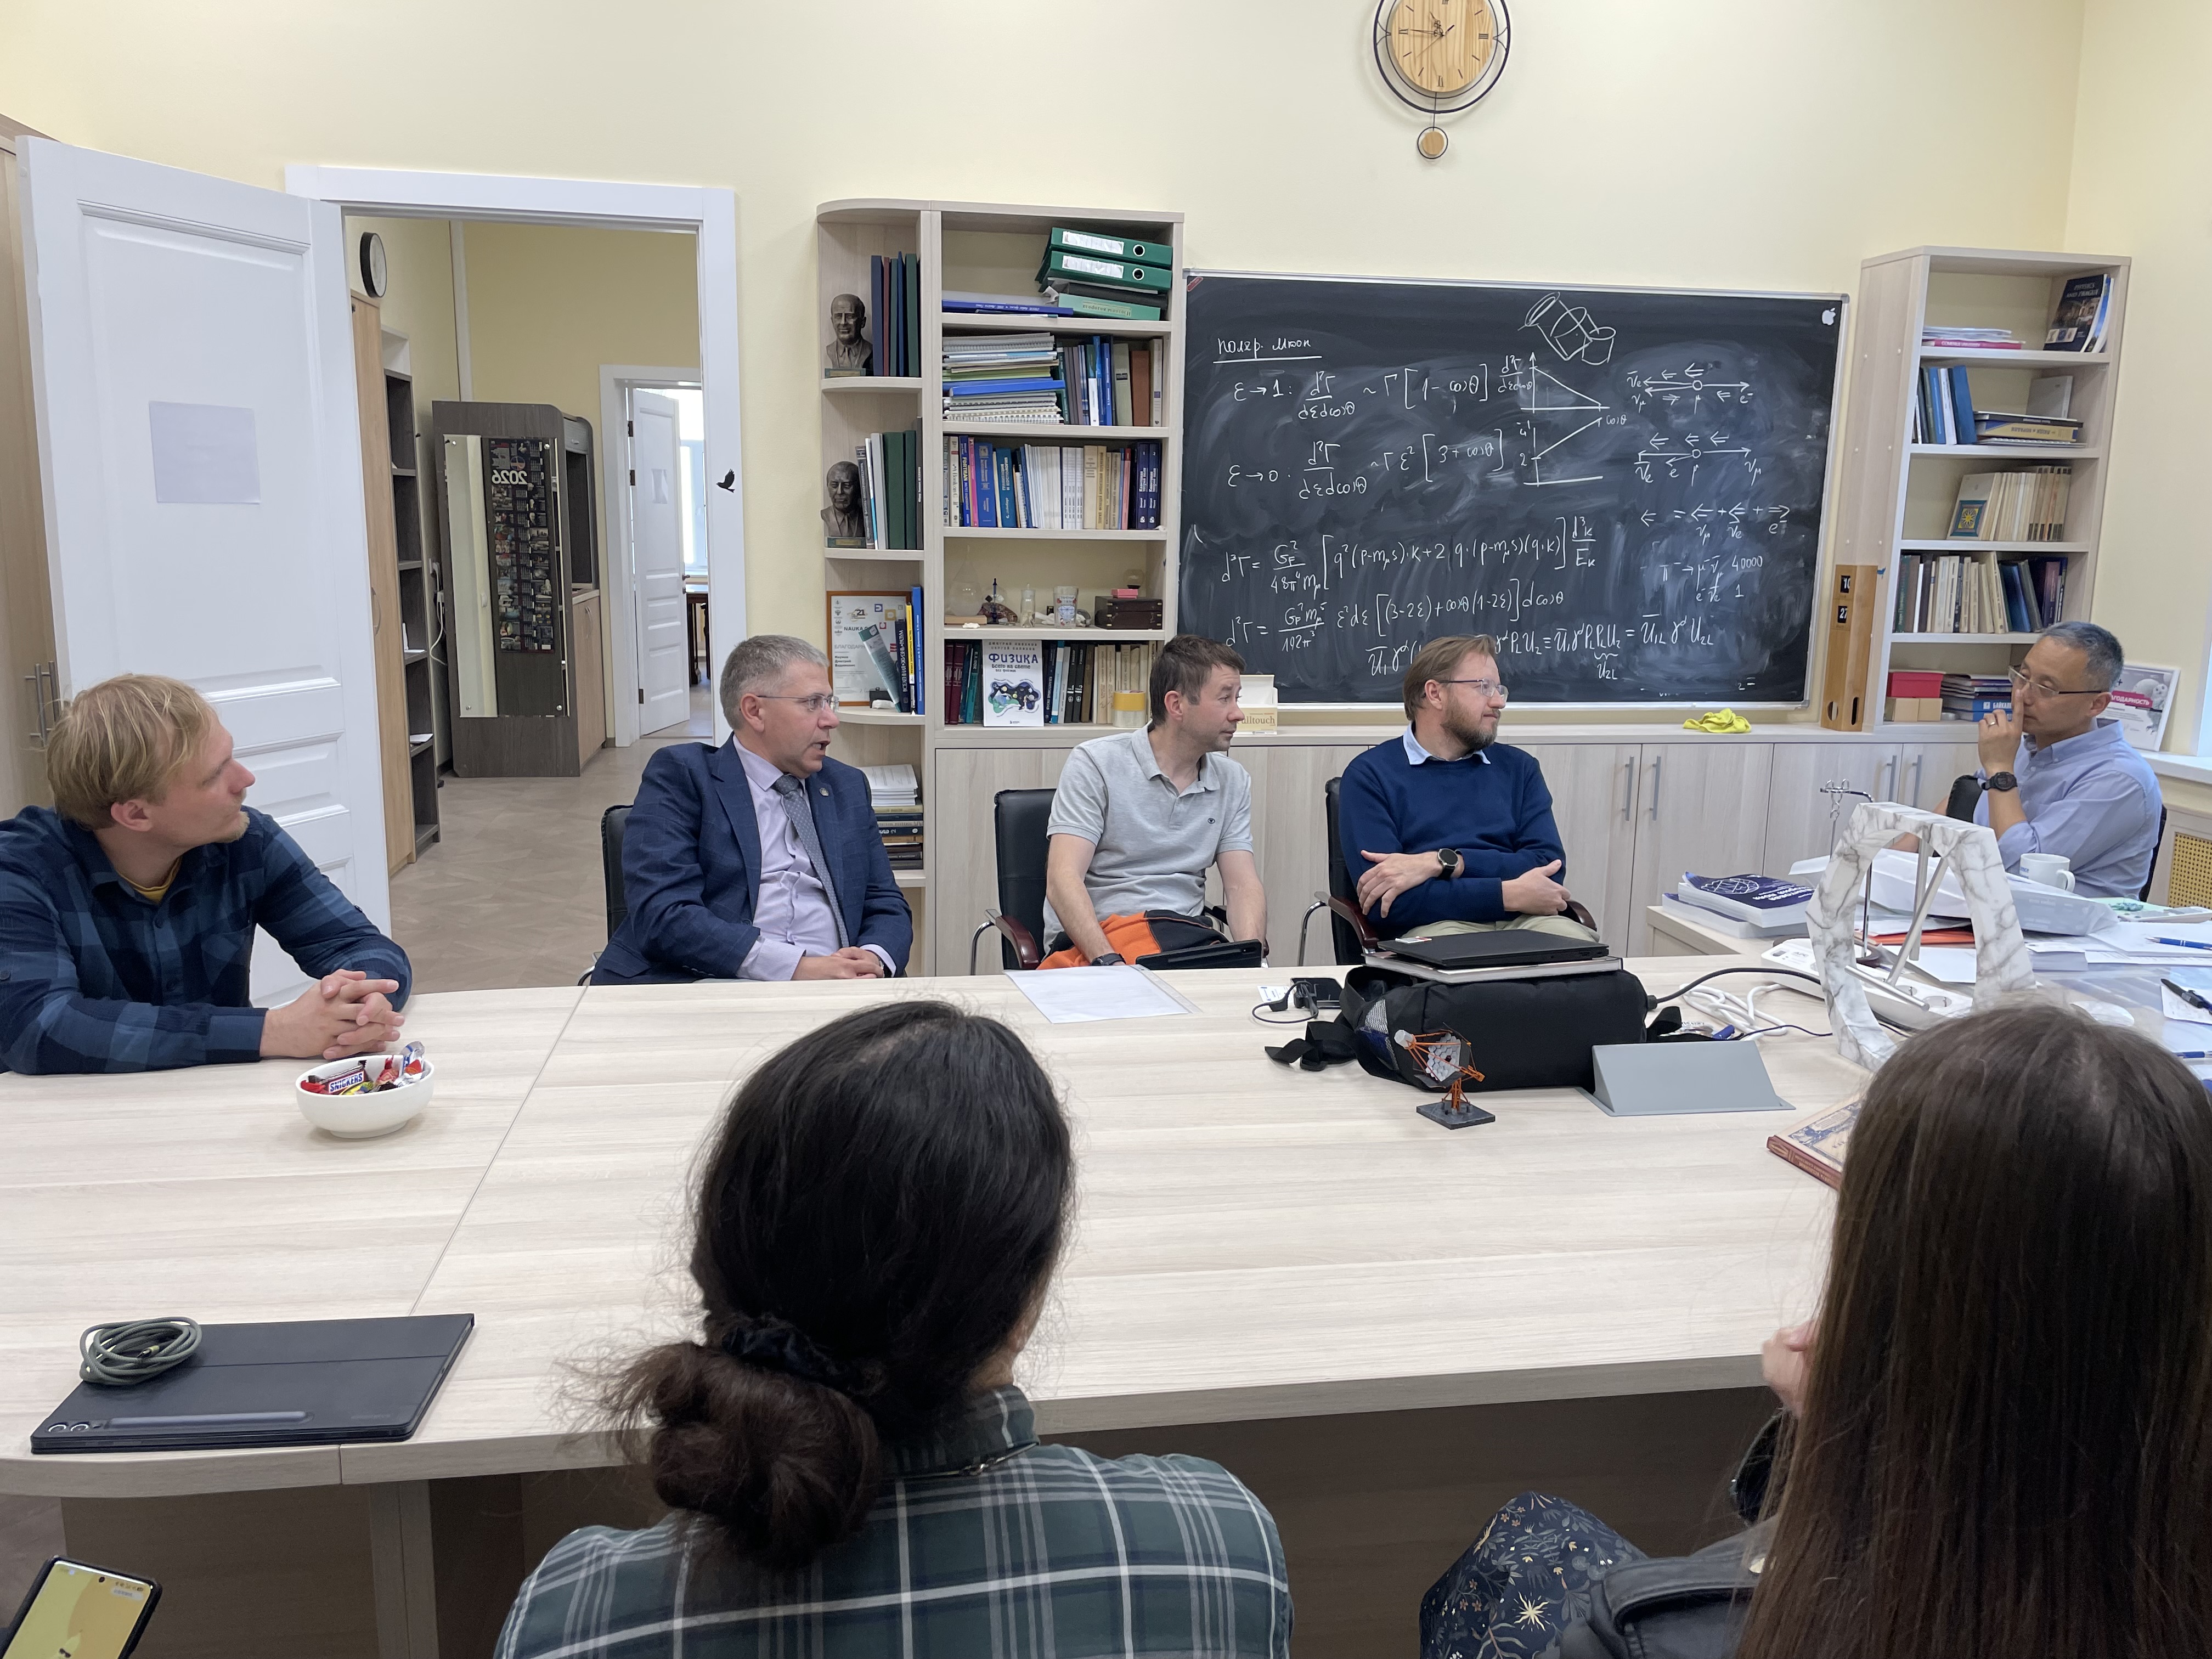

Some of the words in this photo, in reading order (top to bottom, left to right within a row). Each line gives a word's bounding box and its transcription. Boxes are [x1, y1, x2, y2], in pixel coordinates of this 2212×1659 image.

[1731, 556, 1763, 572] 40000
[989, 653, 1039, 664] ФИЗИКА
[2111, 695, 2150, 706] АГОДАРНОСТЬ
[1242, 716, 1276, 724] ulltouch
[330, 1073, 363, 1093] SNICKERS
